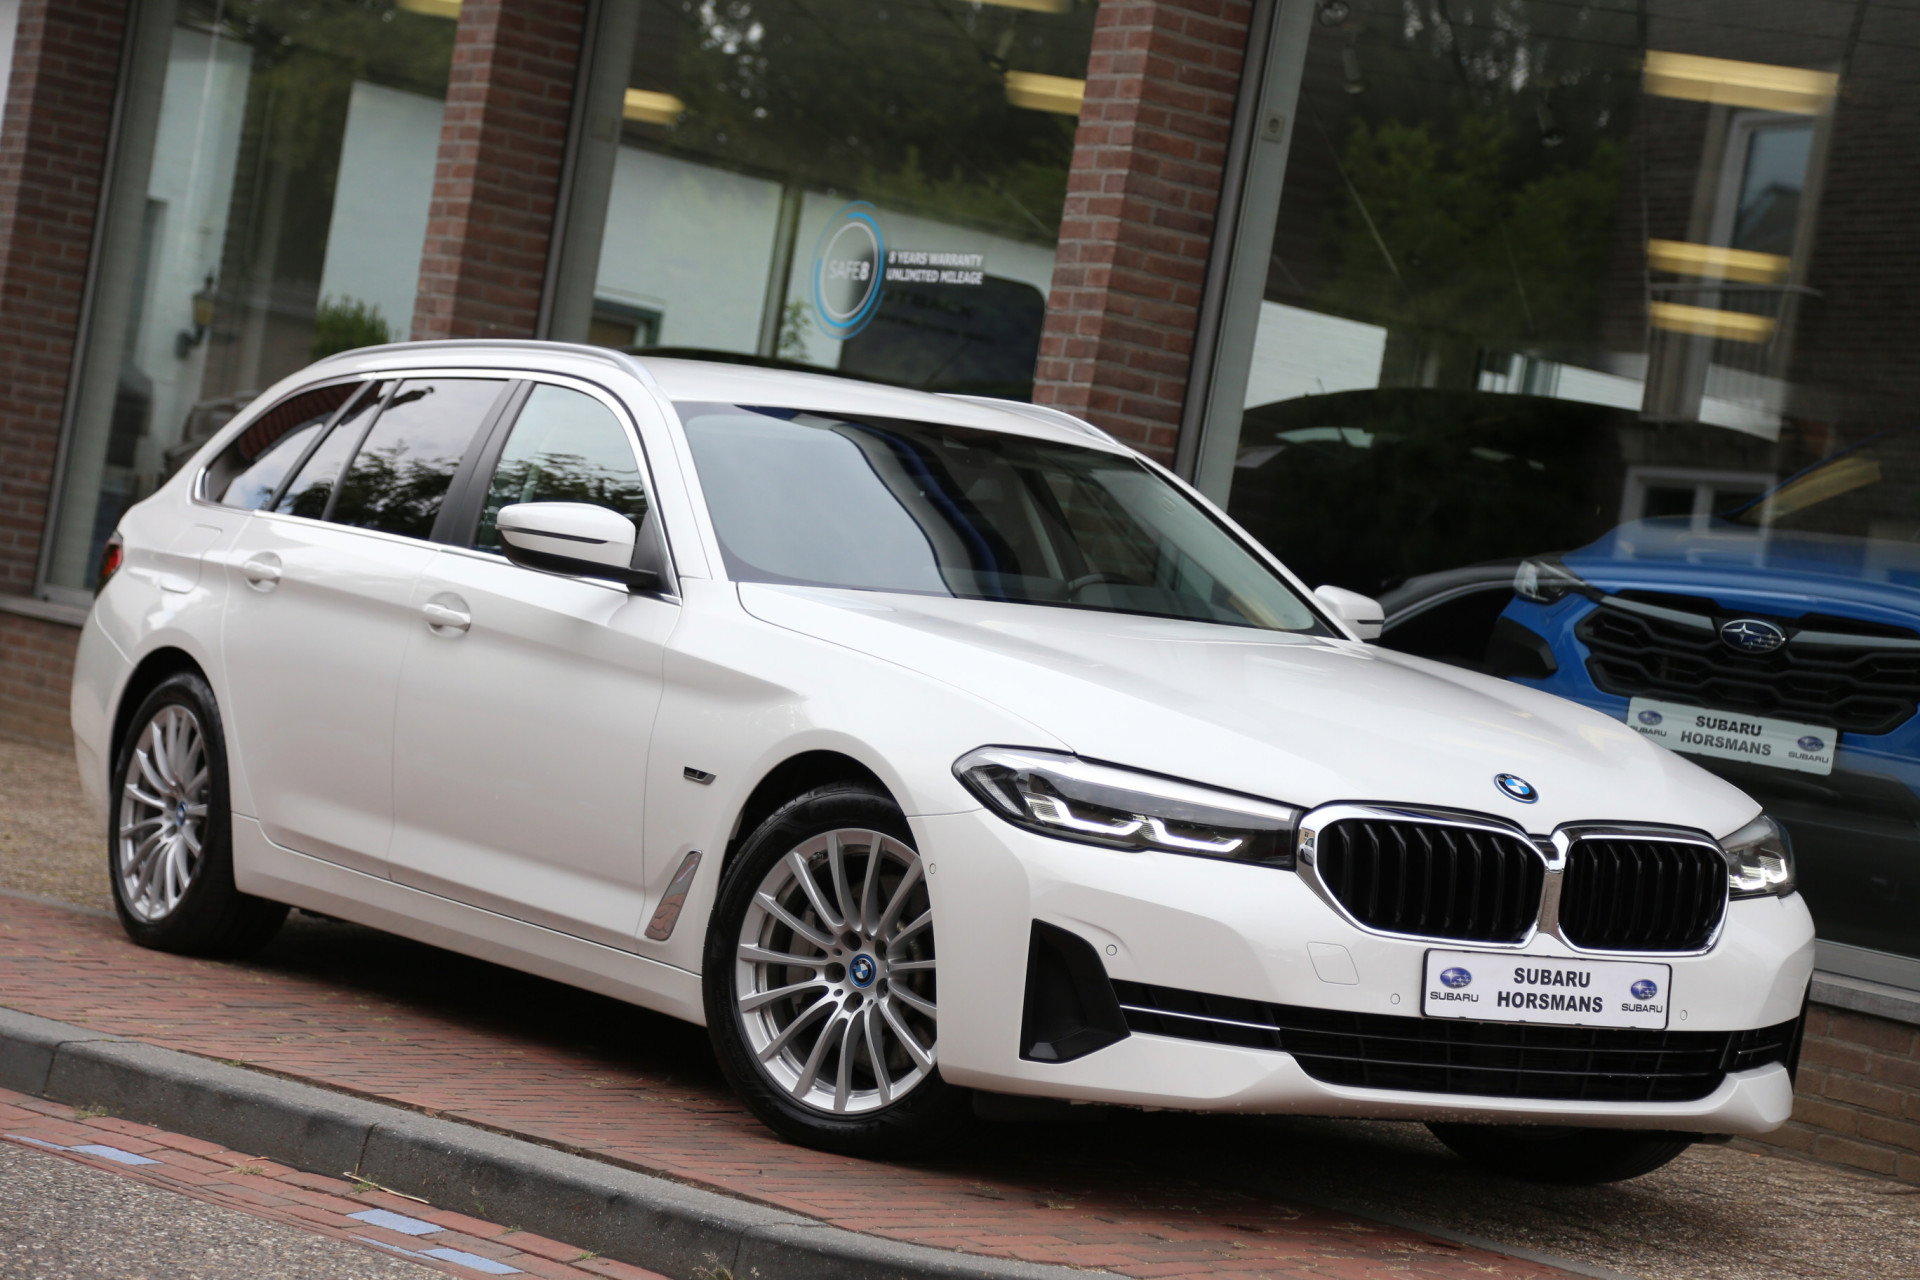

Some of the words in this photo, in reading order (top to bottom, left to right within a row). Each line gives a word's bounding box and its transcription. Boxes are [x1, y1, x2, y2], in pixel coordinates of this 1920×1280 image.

[897, 252, 928, 265] YEARS
[928, 253, 983, 267] WARRANTY
[886, 267, 939, 283] UNLIMITED
[940, 269, 983, 286] MILEAGE
[1695, 716, 1762, 737] SUBARU
[1680, 731, 1772, 756] HORSMANS
[1788, 751, 1830, 764] SUBARU
[1513, 967, 1591, 988] SUBARU
[1430, 991, 1479, 1002] SUBARU
[1497, 991, 1603, 1013] HORSMANS
[1621, 1003, 1663, 1013] SUBARU
